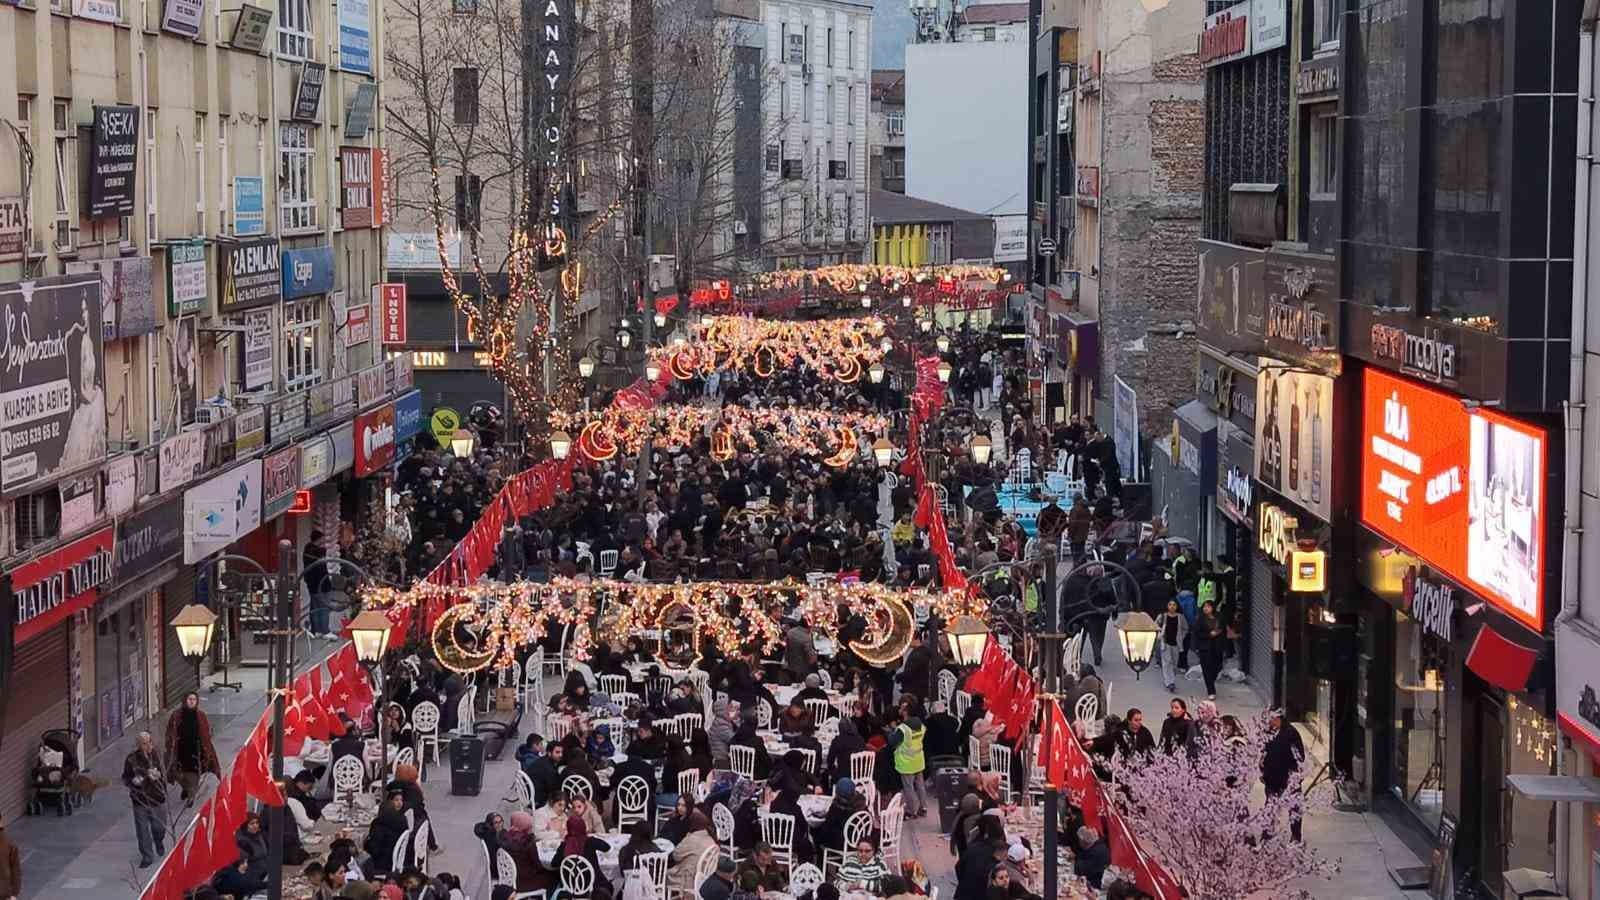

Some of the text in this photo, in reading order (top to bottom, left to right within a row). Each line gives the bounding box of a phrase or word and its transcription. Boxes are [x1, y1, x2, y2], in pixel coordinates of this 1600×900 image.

[247, 244, 279, 273] EMLAK
[412, 351, 446, 366] LTIN
[16, 571, 65, 625] HALICI
[1413, 577, 1454, 642] arçelik
